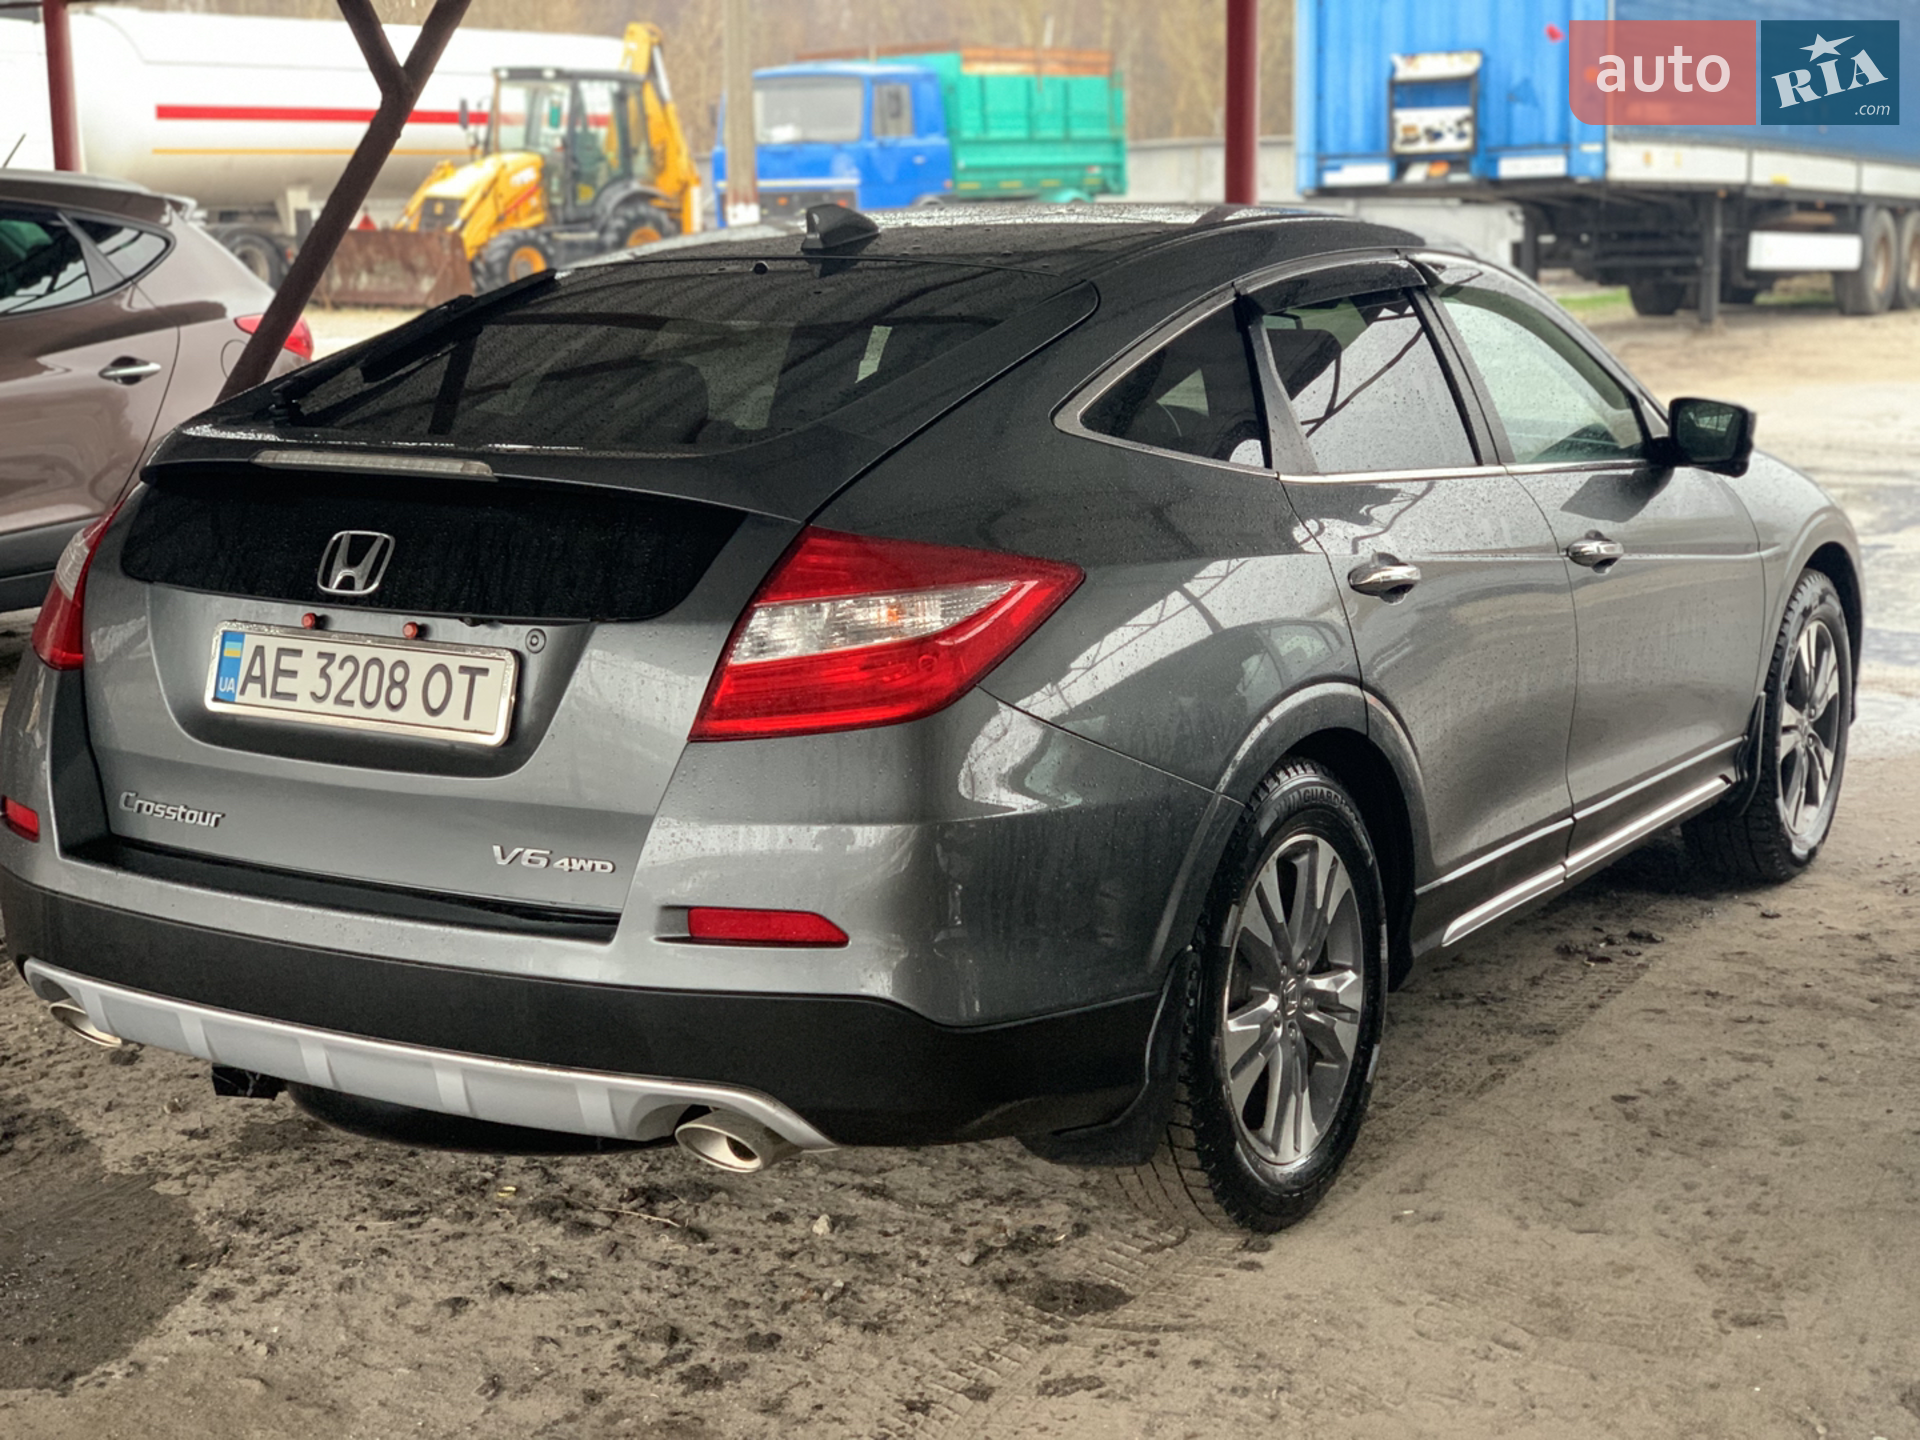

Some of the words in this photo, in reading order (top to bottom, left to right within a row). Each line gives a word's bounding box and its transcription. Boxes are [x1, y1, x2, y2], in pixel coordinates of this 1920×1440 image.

[218, 676, 236, 693] UA
[239, 645, 304, 702] AE
[310, 651, 411, 712] 3208
[422, 663, 490, 721] OT
[119, 791, 225, 828] Crosstour
[492, 844, 553, 868] V6
[553, 857, 616, 873] 4WD
